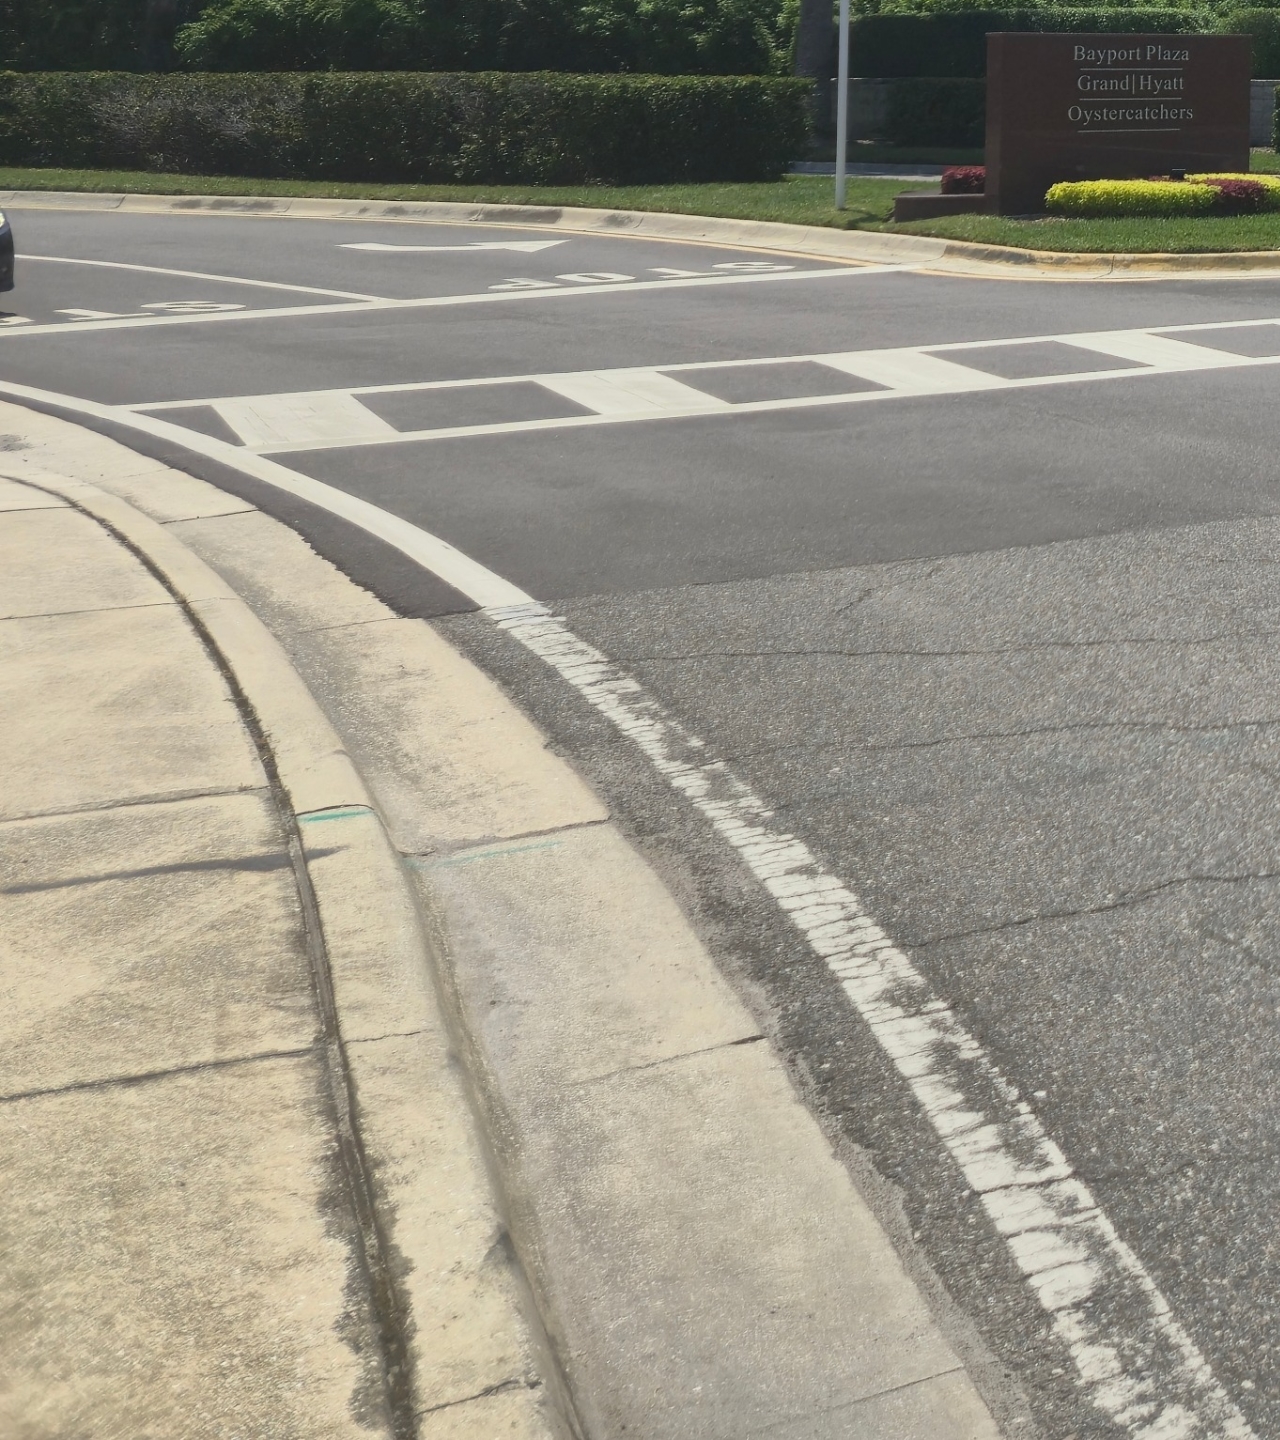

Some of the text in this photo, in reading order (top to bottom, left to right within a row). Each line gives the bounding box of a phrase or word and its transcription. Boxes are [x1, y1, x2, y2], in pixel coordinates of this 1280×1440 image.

[1074, 44, 1189, 65] Bayport Plaza
[1077, 74, 1184, 94] Grand Hyatt
[1067, 104, 1193, 125] Oystercatchers
[487, 261, 797, 290] STOP
